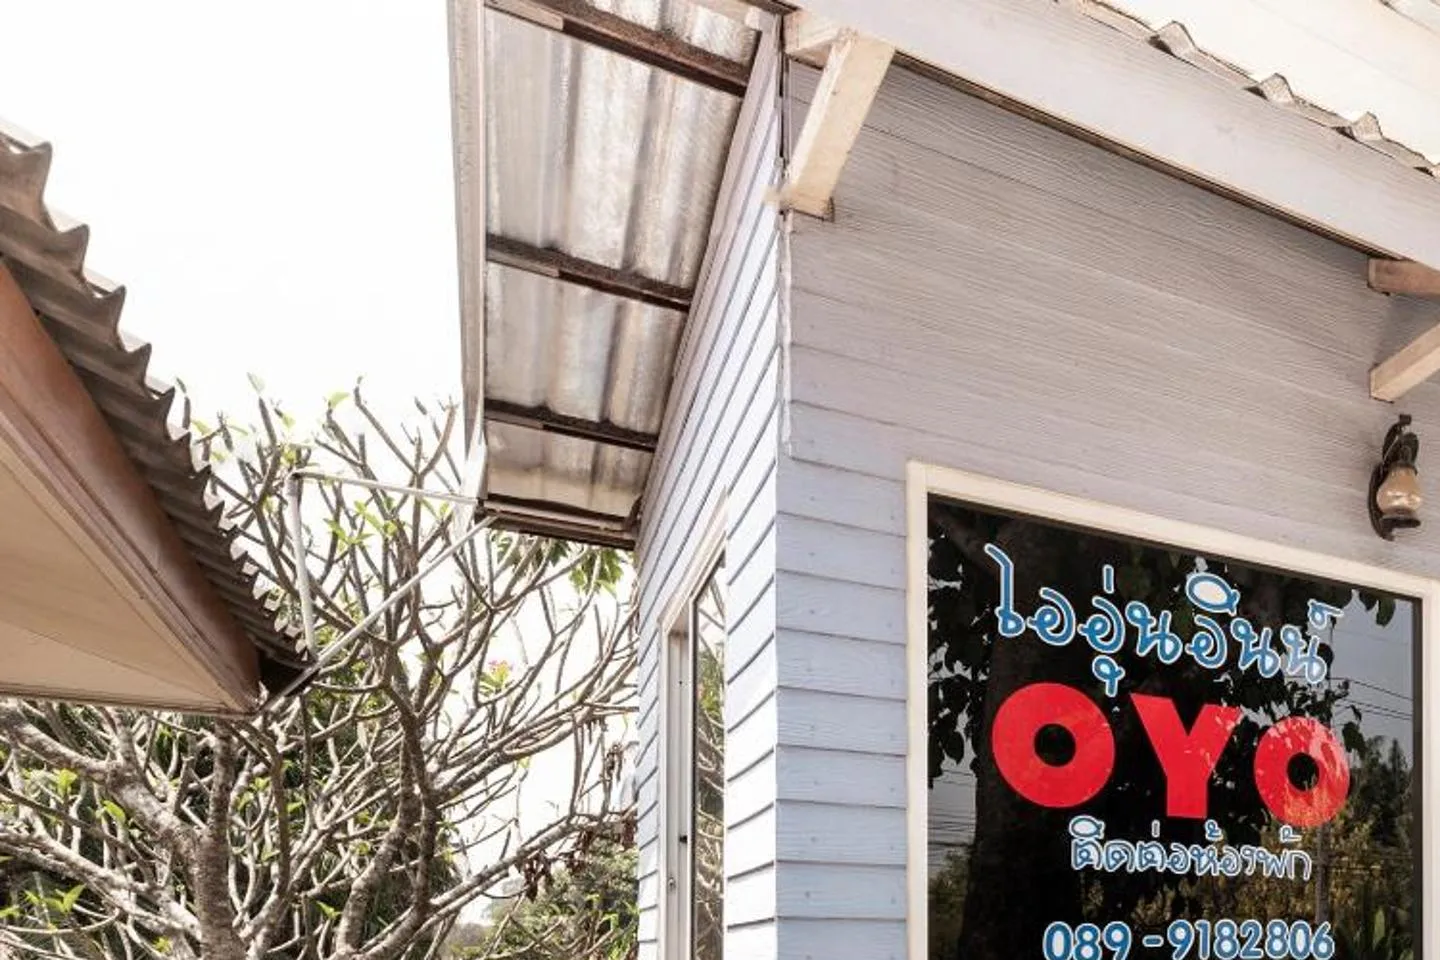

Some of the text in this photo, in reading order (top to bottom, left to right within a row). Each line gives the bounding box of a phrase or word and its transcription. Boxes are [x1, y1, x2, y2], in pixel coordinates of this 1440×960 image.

[984, 543, 1344, 697] ไออุ่นอินน์
[991, 681, 1351, 828] OYO
[1068, 814, 1312, 881] ติดต่อห้องพัก
